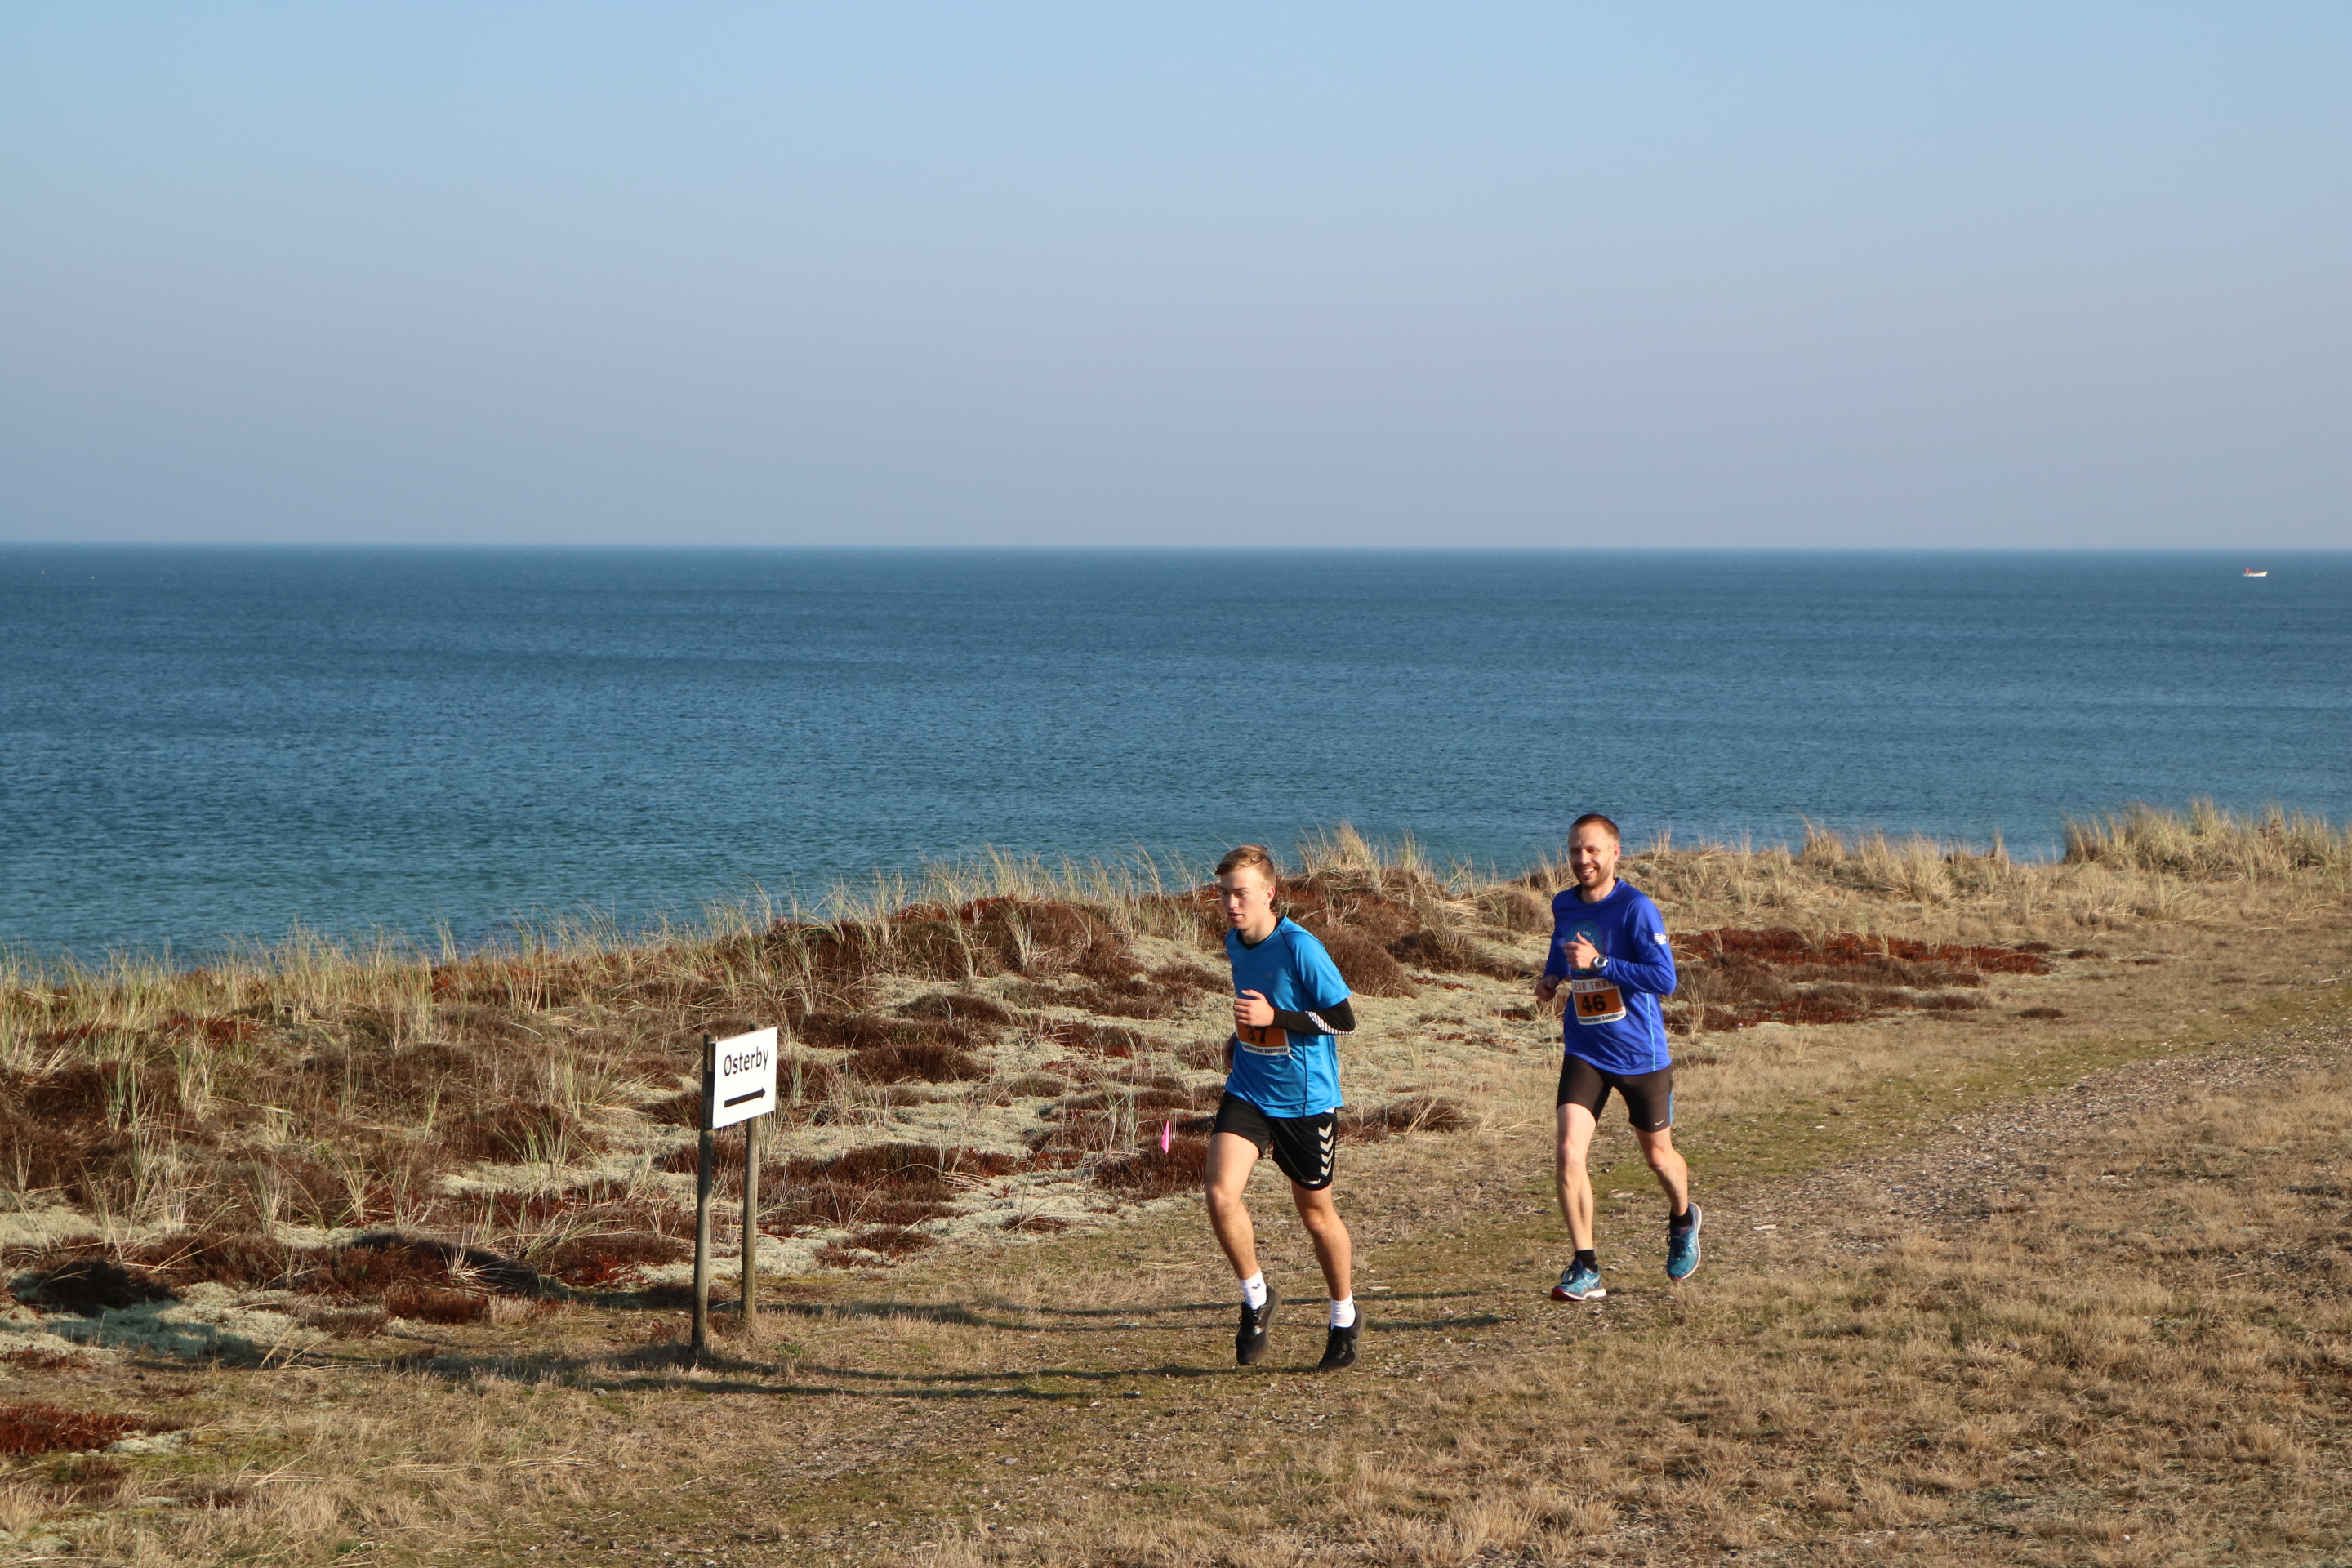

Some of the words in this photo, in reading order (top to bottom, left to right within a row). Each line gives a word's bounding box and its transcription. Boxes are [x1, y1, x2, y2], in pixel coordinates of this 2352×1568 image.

[1582, 994, 1607, 1013] 46
[1245, 1025, 1267, 1044] 37
[723, 1045, 769, 1080] Østerby
